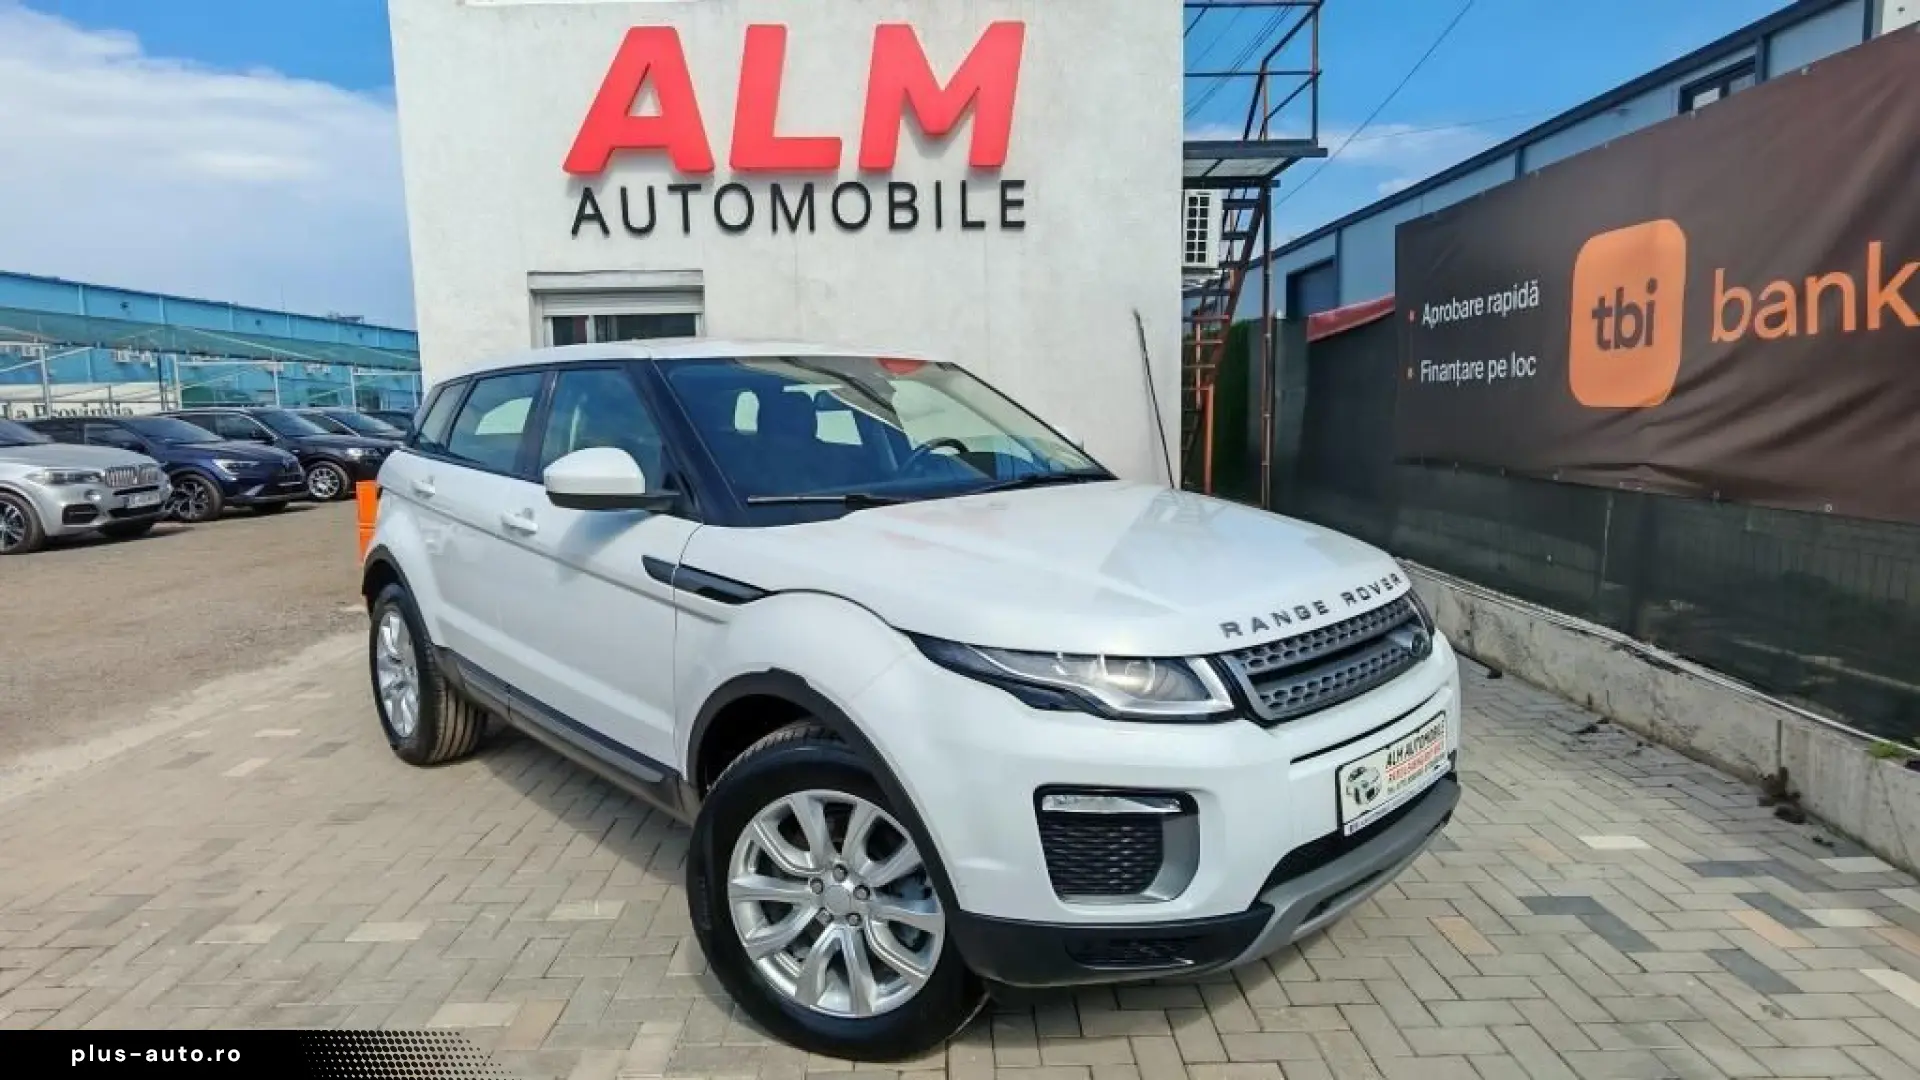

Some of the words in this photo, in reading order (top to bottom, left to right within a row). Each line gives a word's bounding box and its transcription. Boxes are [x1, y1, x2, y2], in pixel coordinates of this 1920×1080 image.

[562, 20, 1025, 173] ALM
[571, 180, 1026, 237] AUTOMOBILE
[1422, 296, 1484, 329] Aprobare
[1487, 279, 1540, 318] rapidă
[1591, 277, 1658, 351] tbi
[1711, 240, 1920, 343] bank
[1420, 359, 1484, 387] Finanțare
[1488, 358, 1508, 384] pe
[1511, 351, 1537, 378] loc
[1219, 600, 1330, 638] RANGE
[1340, 573, 1402, 607] ROVER
